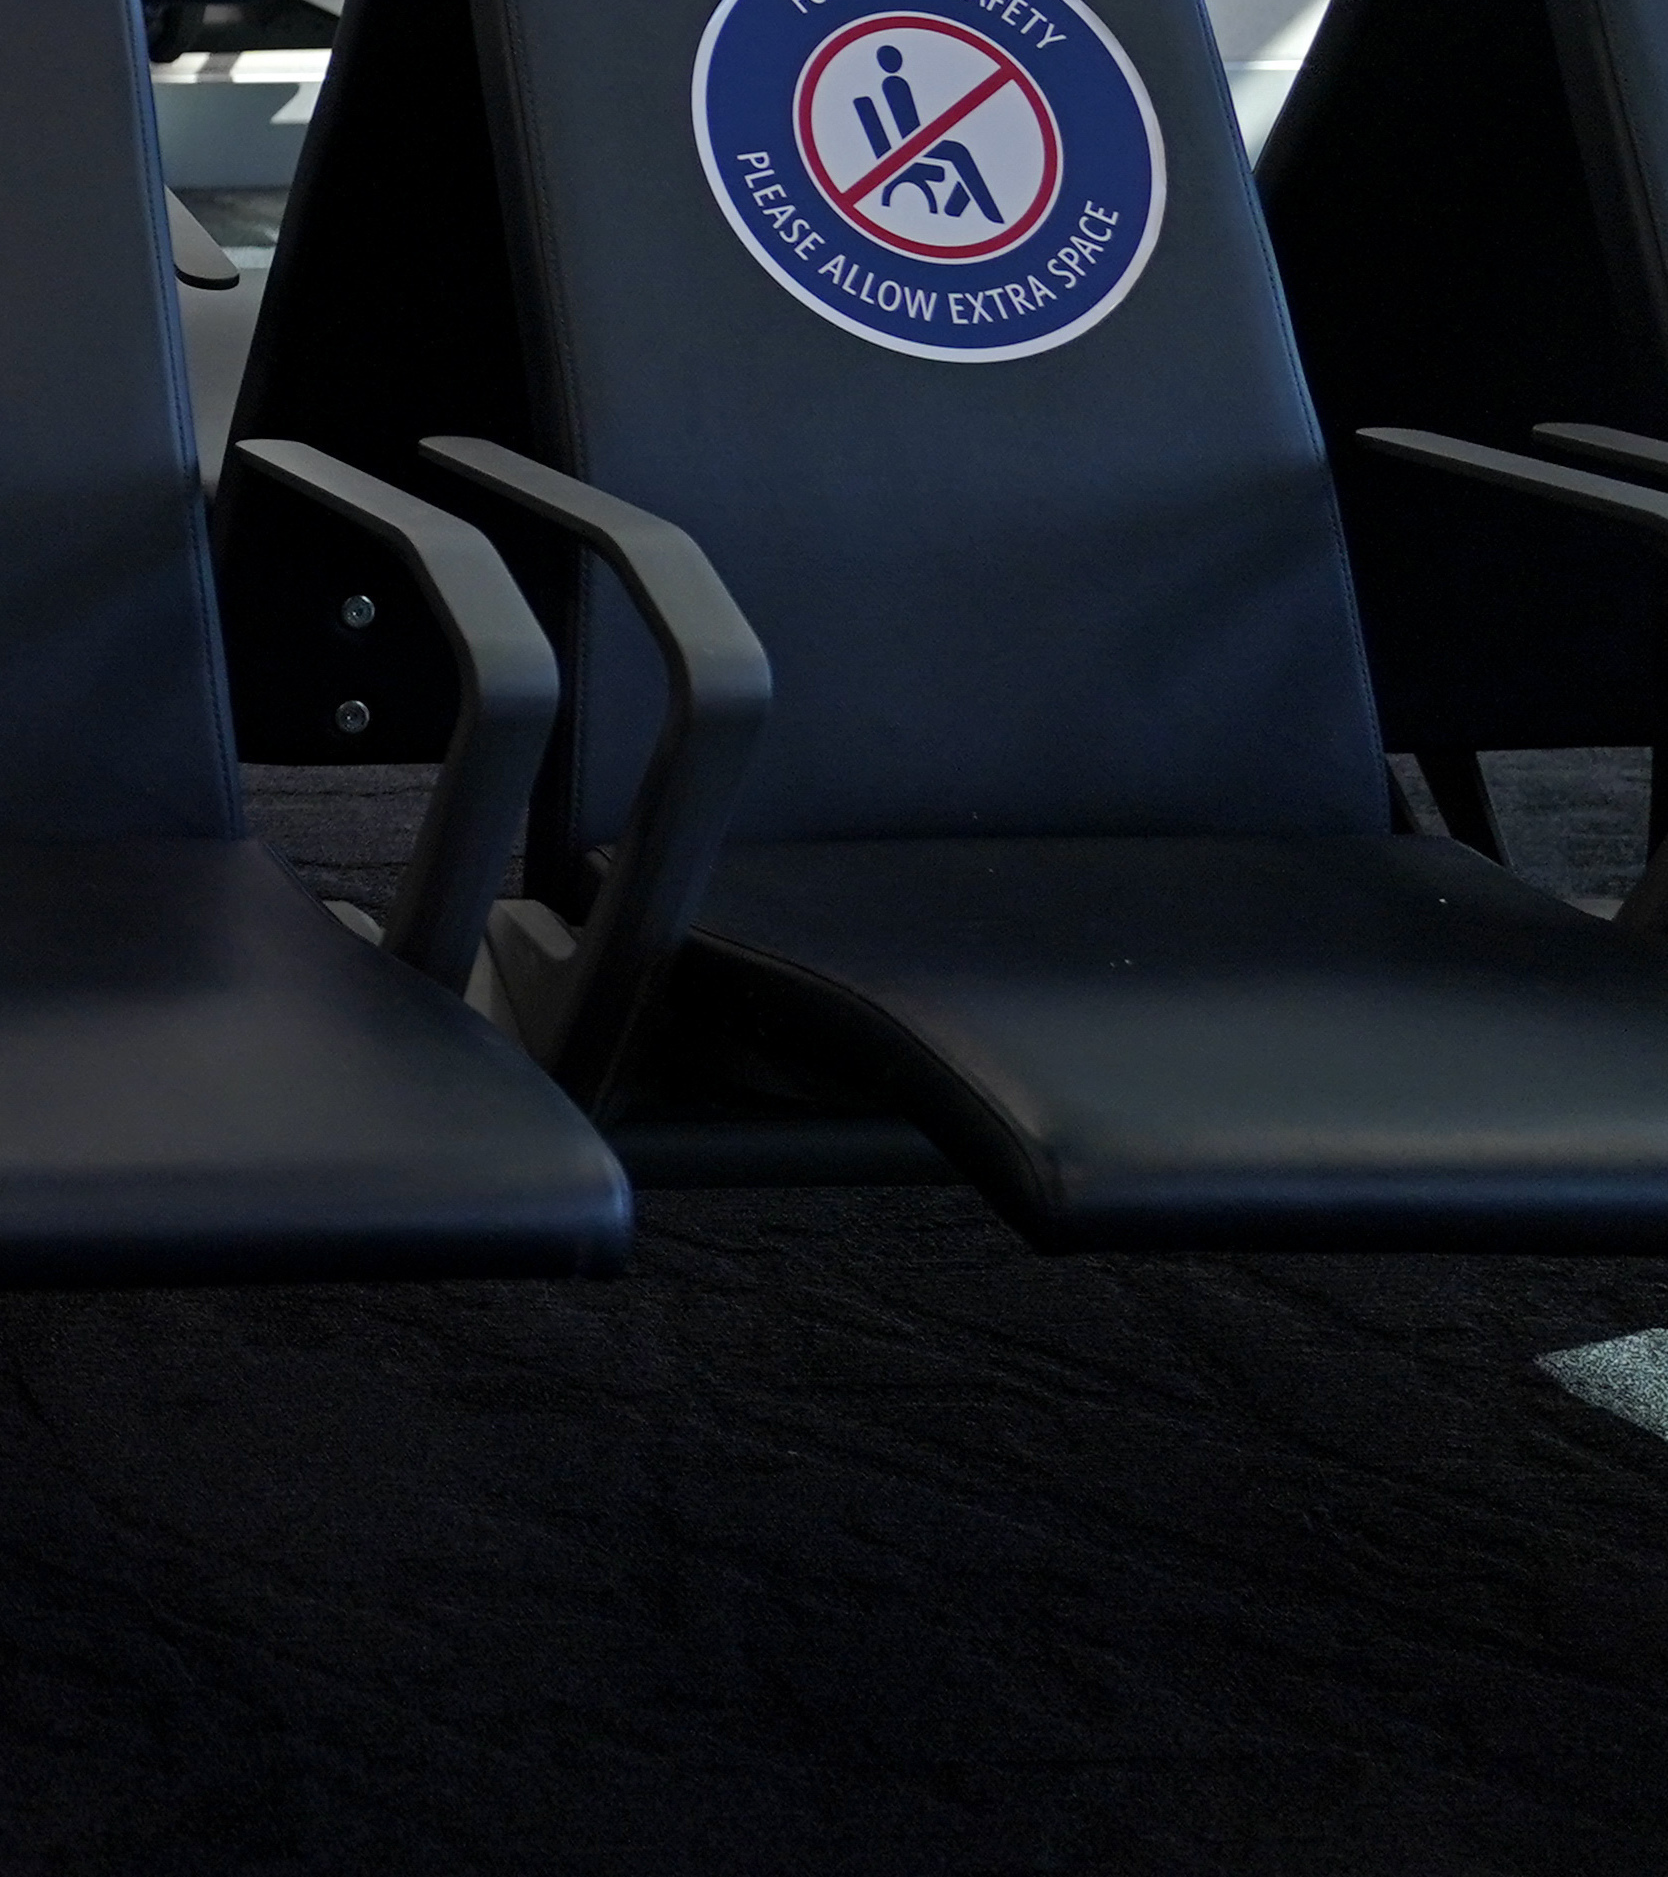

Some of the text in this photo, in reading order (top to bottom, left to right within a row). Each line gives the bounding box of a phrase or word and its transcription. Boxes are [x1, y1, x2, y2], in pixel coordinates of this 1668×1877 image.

[737, 150, 1120, 324] PLEASE ALLOW EXTRA SPACE
